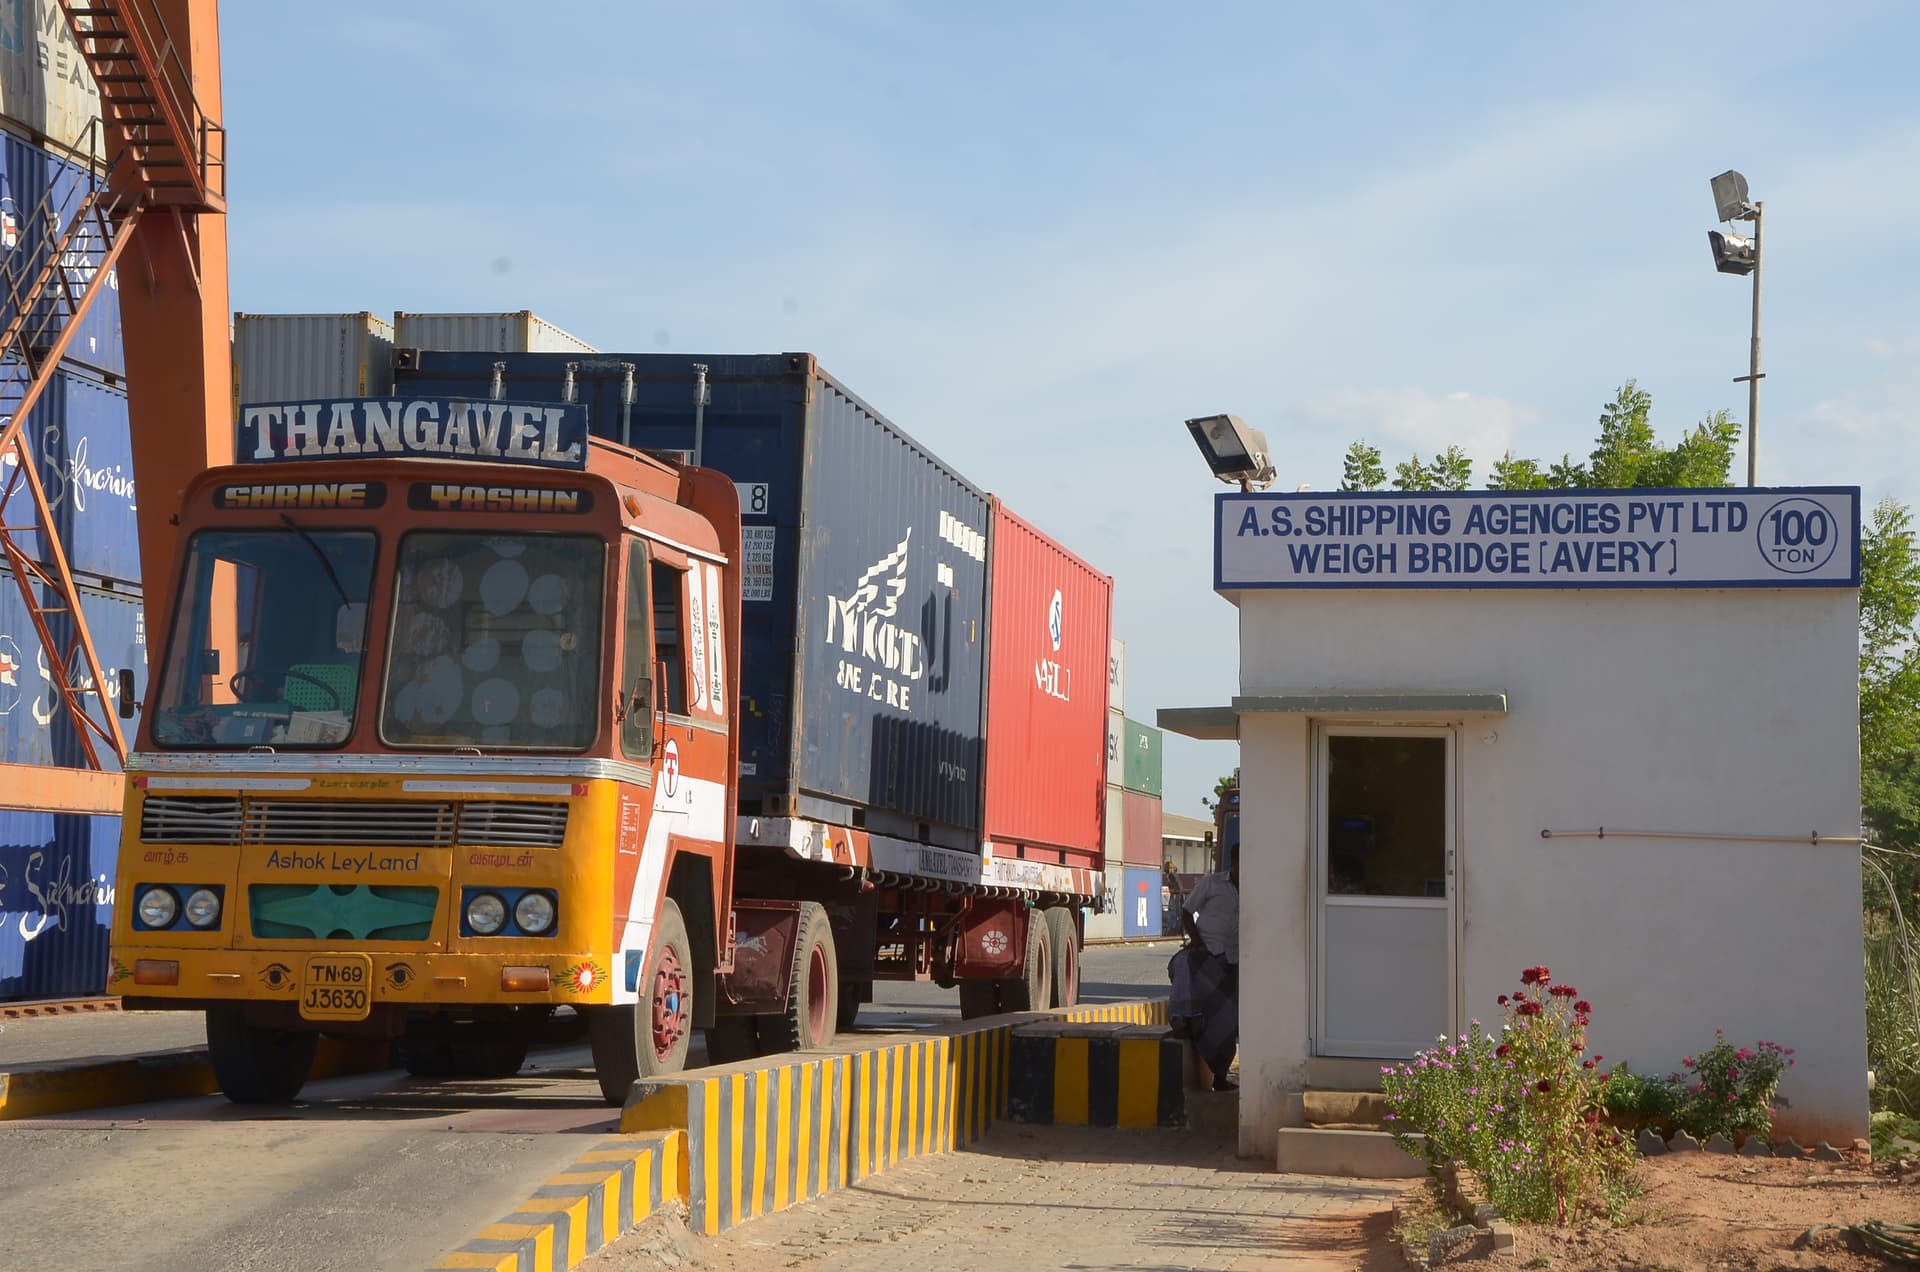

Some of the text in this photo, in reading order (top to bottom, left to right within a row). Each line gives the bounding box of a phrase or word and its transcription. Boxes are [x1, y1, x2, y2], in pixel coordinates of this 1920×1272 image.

[244, 401, 582, 463] THANGAVEL
[224, 483, 367, 508] SHRINE
[431, 484, 578, 513] YASHIN
[1463, 502, 1621, 536] AGENCIES
[1628, 502, 1684, 534] PVT
[1692, 501, 1748, 533] LTD
[1770, 509, 1828, 547] 100
[1287, 543, 1398, 575] WEIGH
[1408, 542, 1530, 575] BRIDGE
[1772, 548, 1816, 564] TON
[266, 849, 326, 870] Ashok
